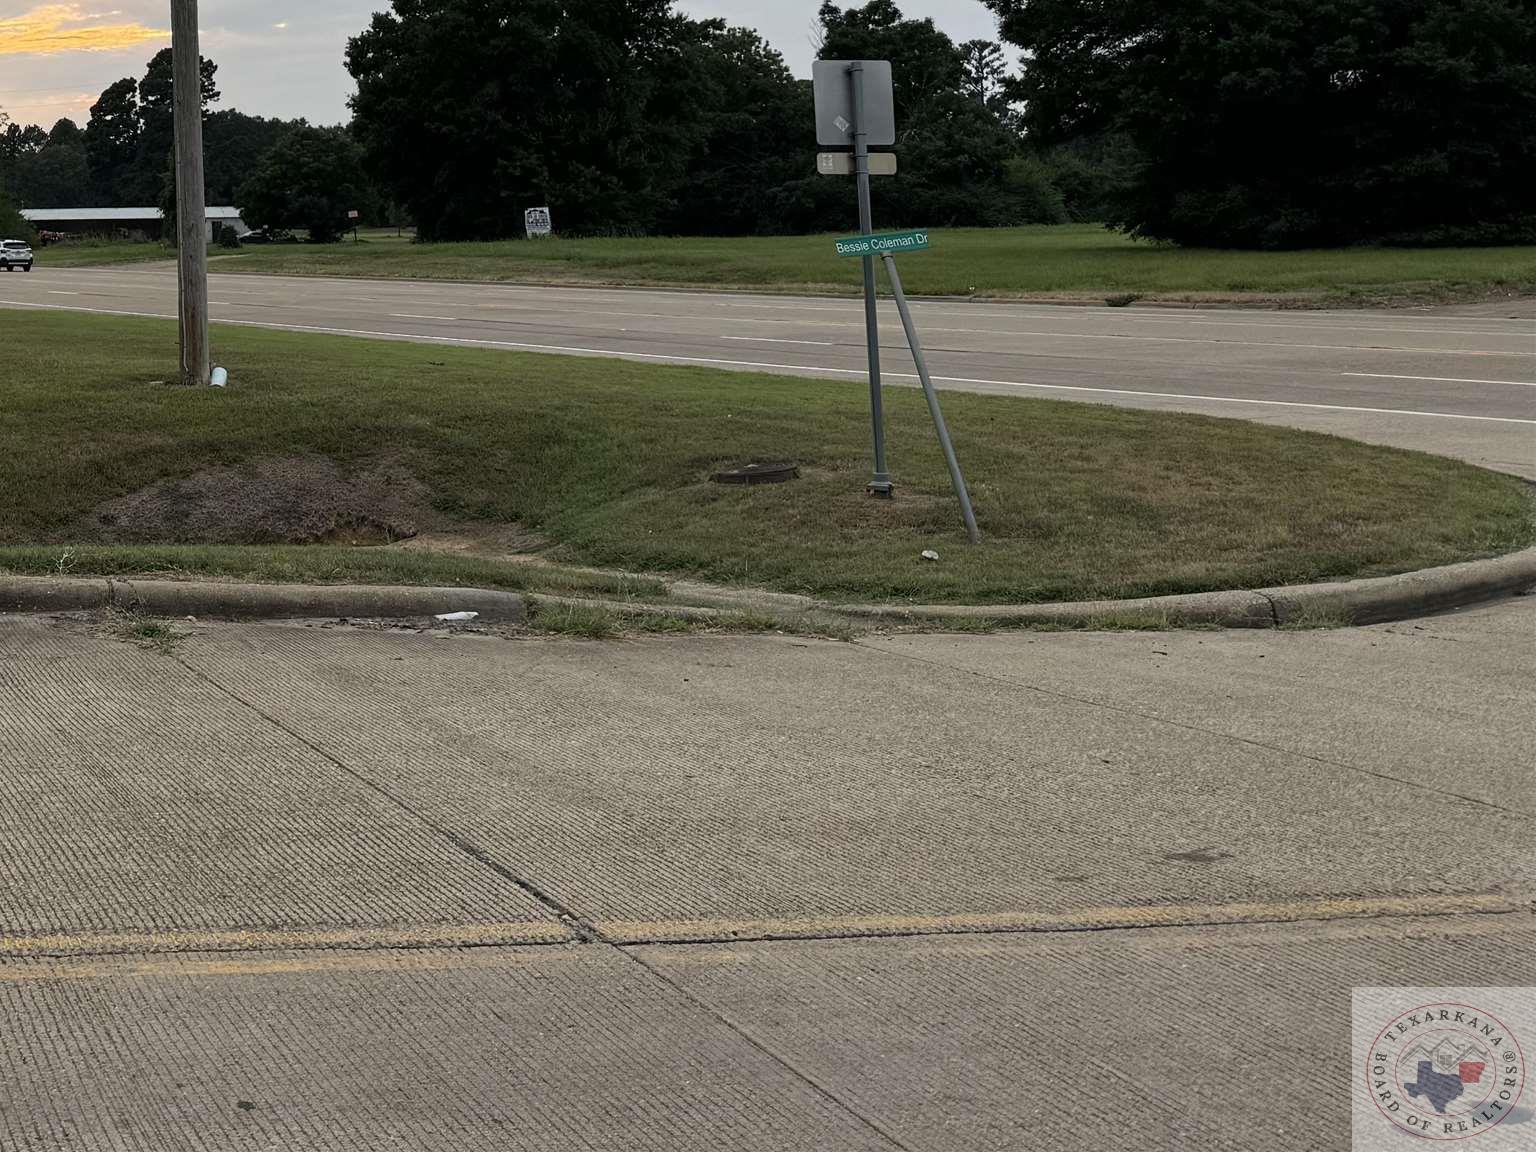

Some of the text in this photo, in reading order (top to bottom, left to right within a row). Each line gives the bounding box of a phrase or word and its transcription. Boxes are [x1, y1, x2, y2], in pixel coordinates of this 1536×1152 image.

[835, 233, 928, 253] Bessie Coleman Dr
